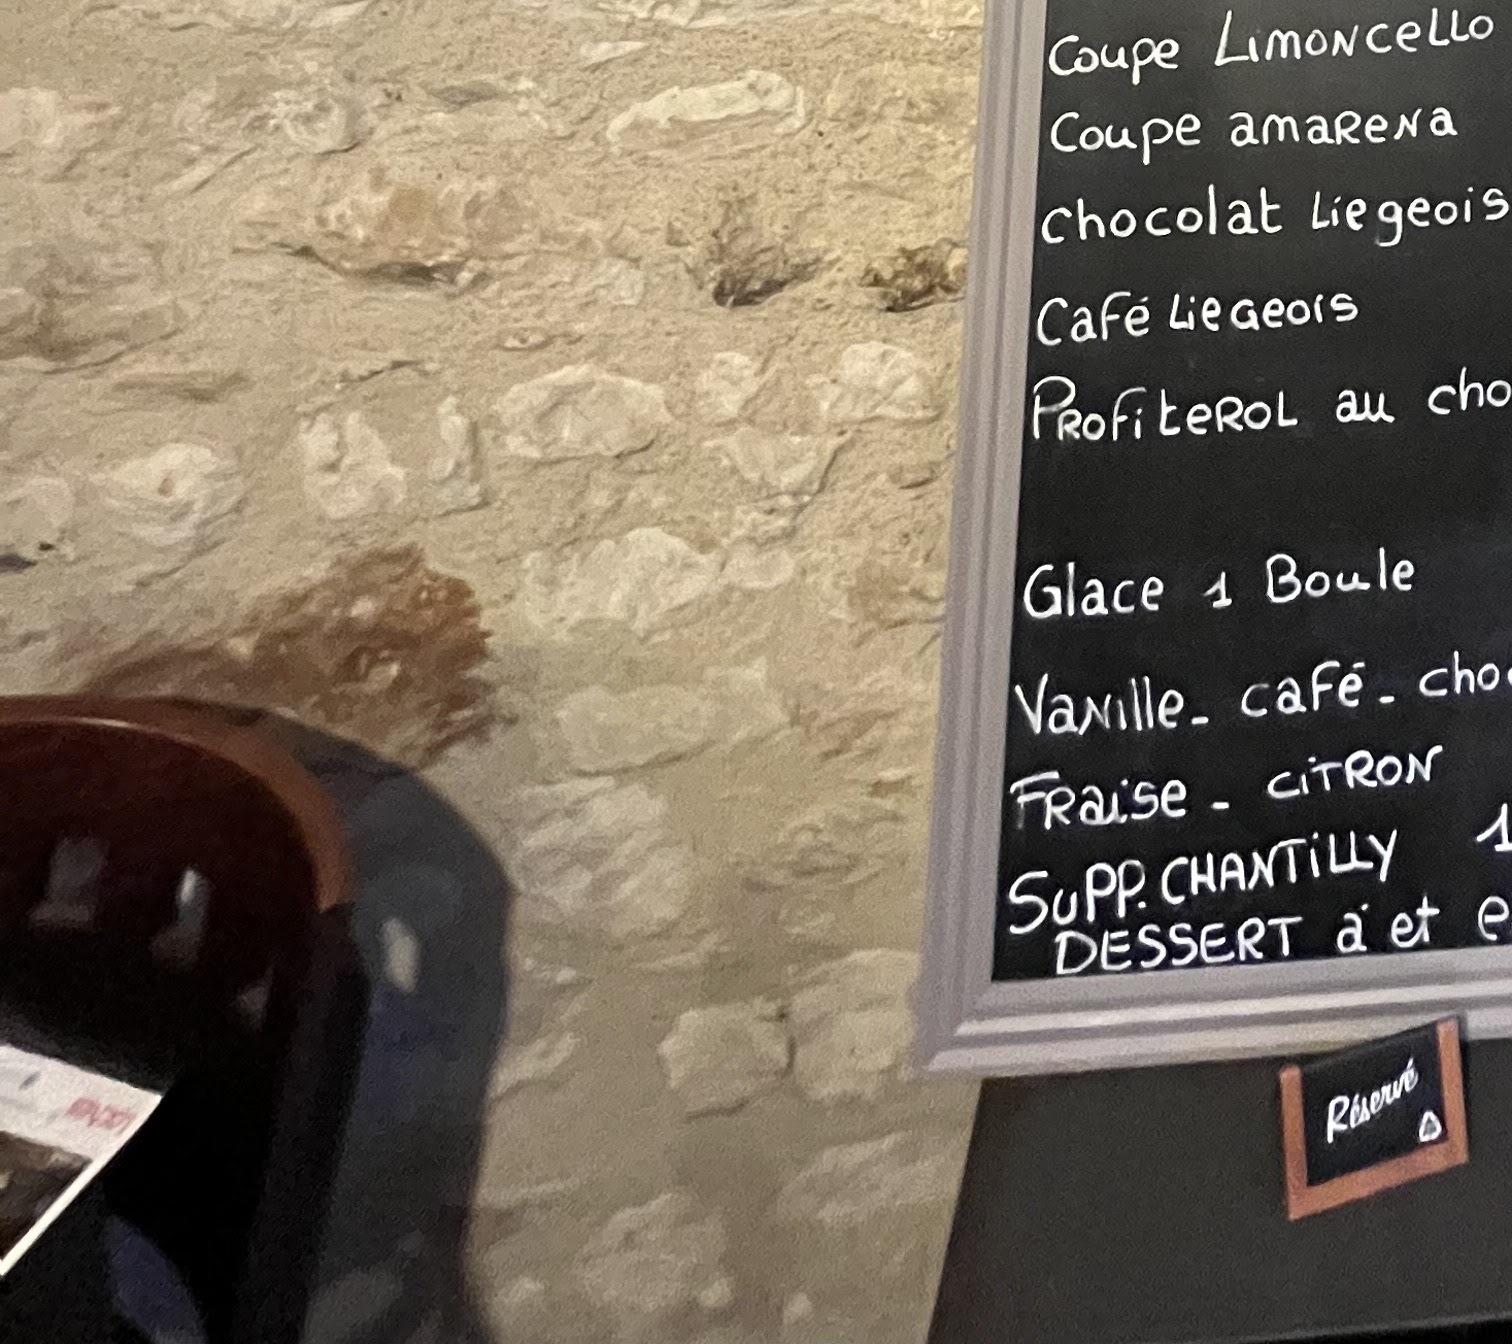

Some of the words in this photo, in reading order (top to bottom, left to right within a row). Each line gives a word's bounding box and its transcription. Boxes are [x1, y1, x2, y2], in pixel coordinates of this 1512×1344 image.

[1048, 35, 1181, 86] Coupe
[1050, 111, 1201, 166] Coupe
[1041, 183, 1284, 245] chocolat
[1036, 290, 1152, 347] Café
[1335, 388, 1396, 424] au
[1022, 561, 1166, 619] Glace
[1202, 570, 1233, 609] 1
[1266, 546, 1416, 604] Boule
[1009, 769, 1188, 831] Fraise
[1053, 916, 1303, 976] DESSERT
[1390, 894, 1441, 949] et
